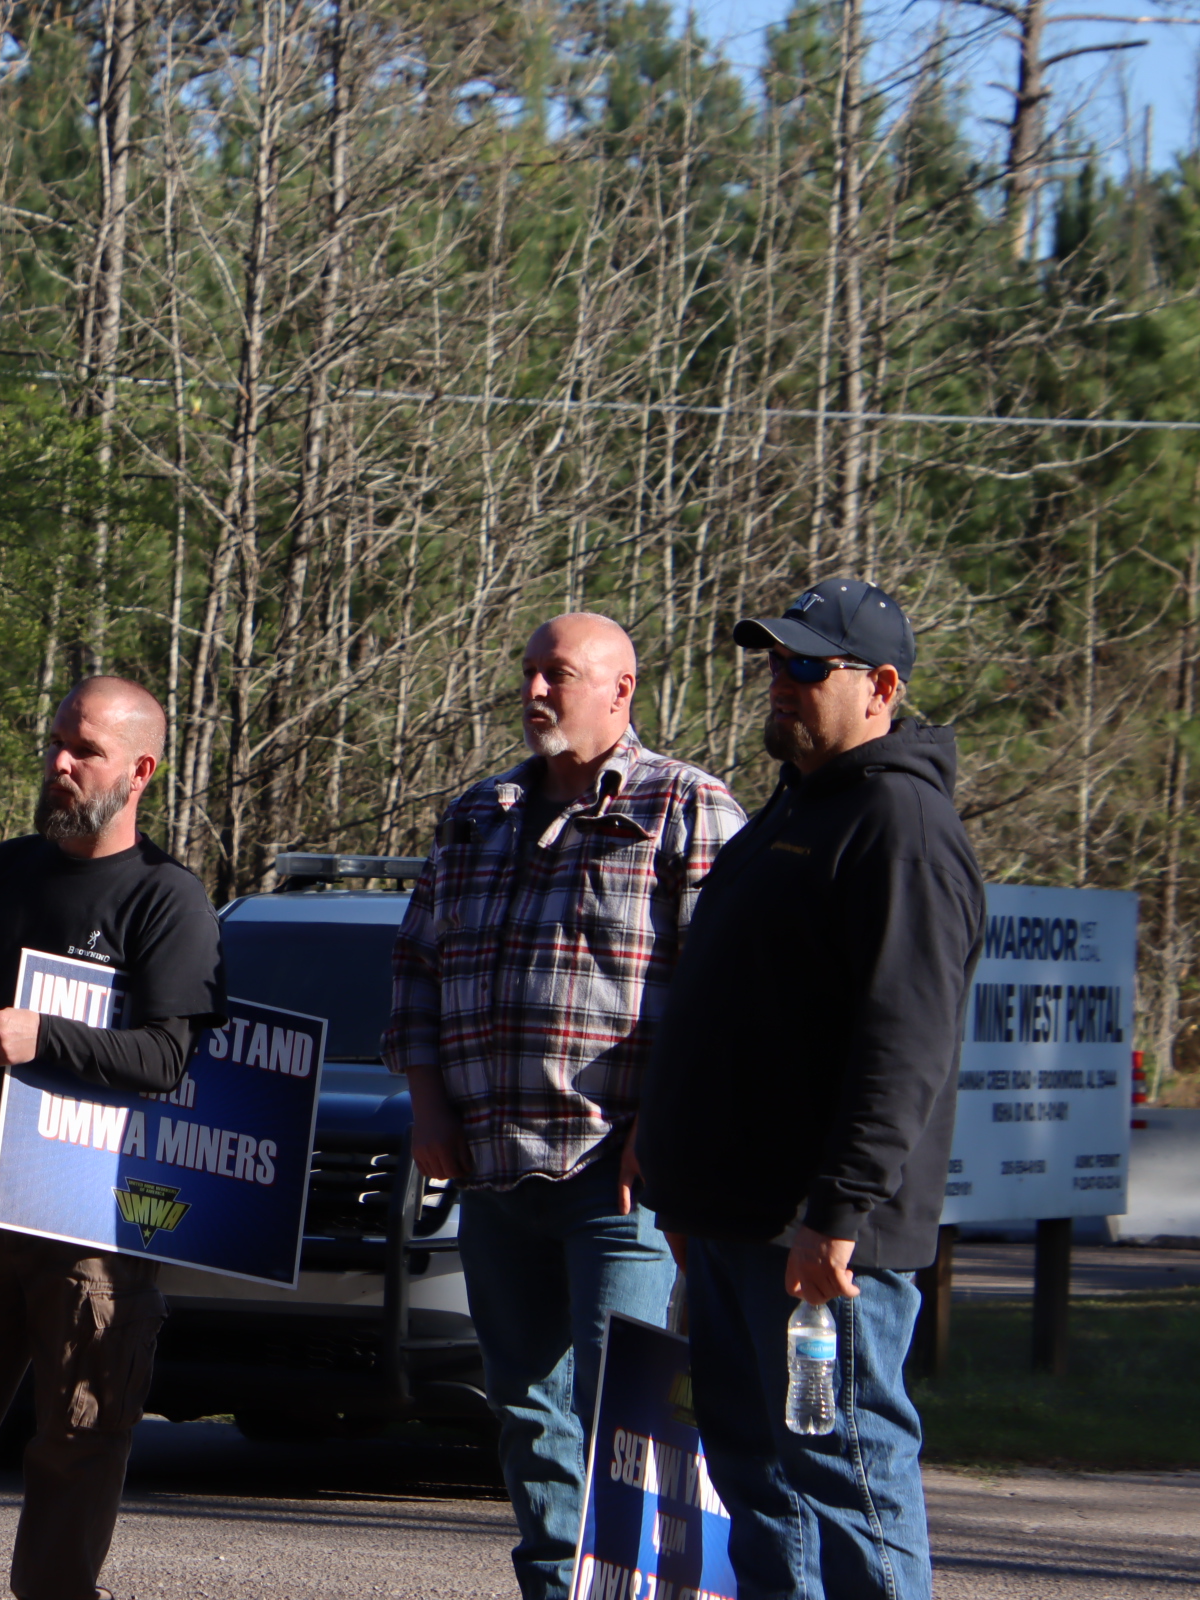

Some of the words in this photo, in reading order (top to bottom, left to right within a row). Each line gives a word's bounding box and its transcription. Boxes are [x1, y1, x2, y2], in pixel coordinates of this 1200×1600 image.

[984, 914, 1079, 962] WARRIOR
[973, 983, 1015, 1043] MINE
[1018, 984, 1063, 1043] WEST
[1064, 984, 1123, 1043] PORTAL
[209, 1017, 313, 1078] STAND
[38, 1090, 146, 1159] UMWA
[156, 1116, 277, 1185] MINERS
[115, 1190, 187, 1230] UMWA
[611, 1428, 682, 1501] MINERS
